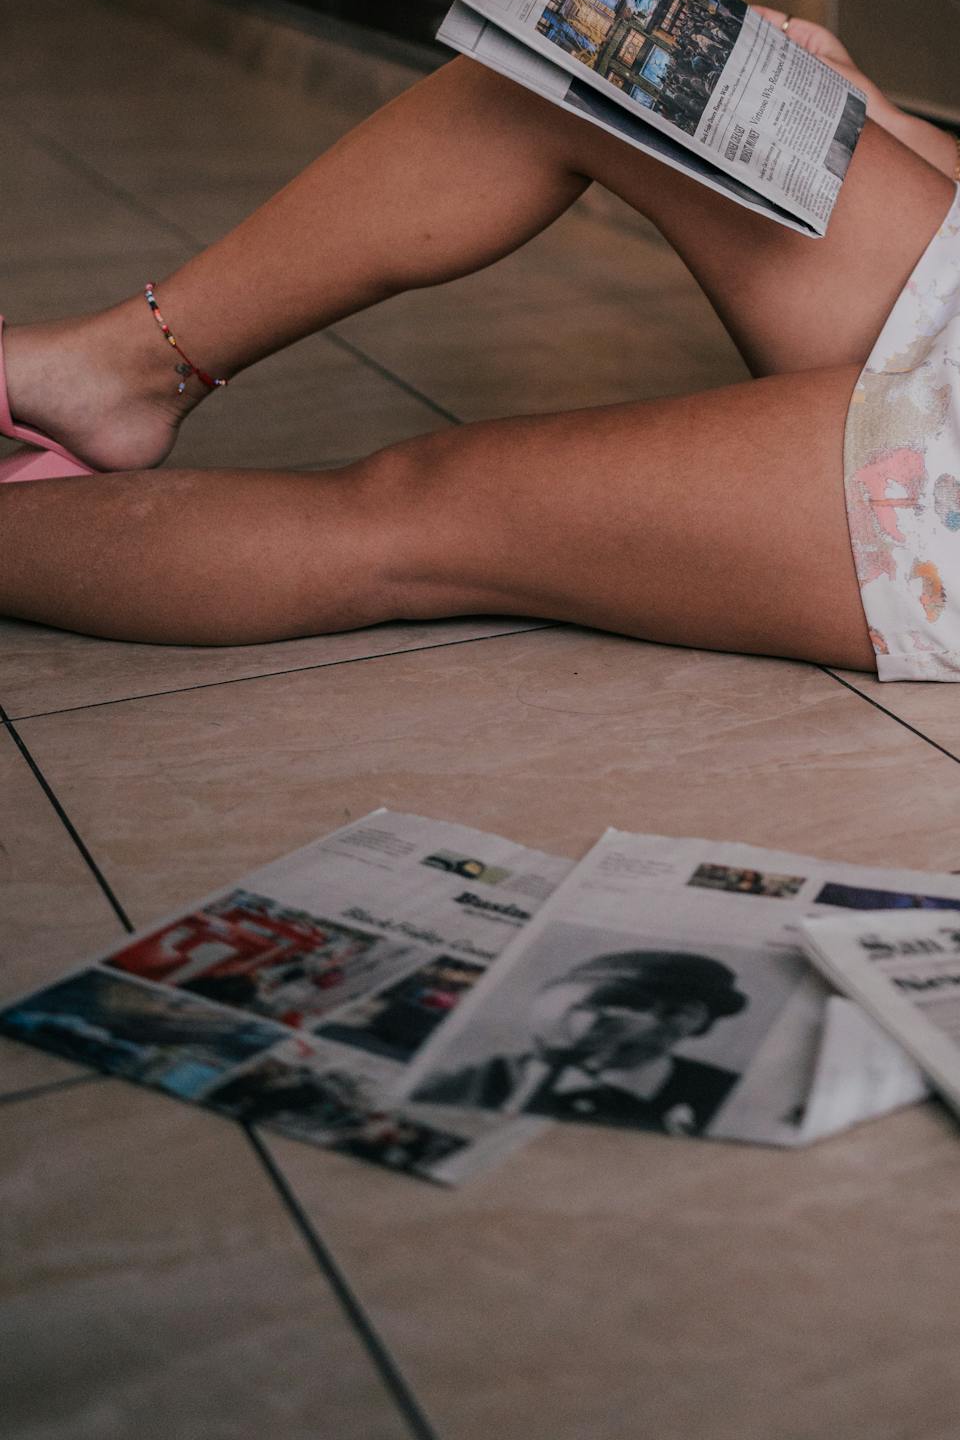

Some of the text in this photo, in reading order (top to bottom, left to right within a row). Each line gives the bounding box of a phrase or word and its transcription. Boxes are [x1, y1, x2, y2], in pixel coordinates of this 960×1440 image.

[749, 96, 769, 126] Virtuoso
[762, 83, 776, 100] Who
[453, 890, 532, 921] Busin
[858, 933, 940, 961] San
